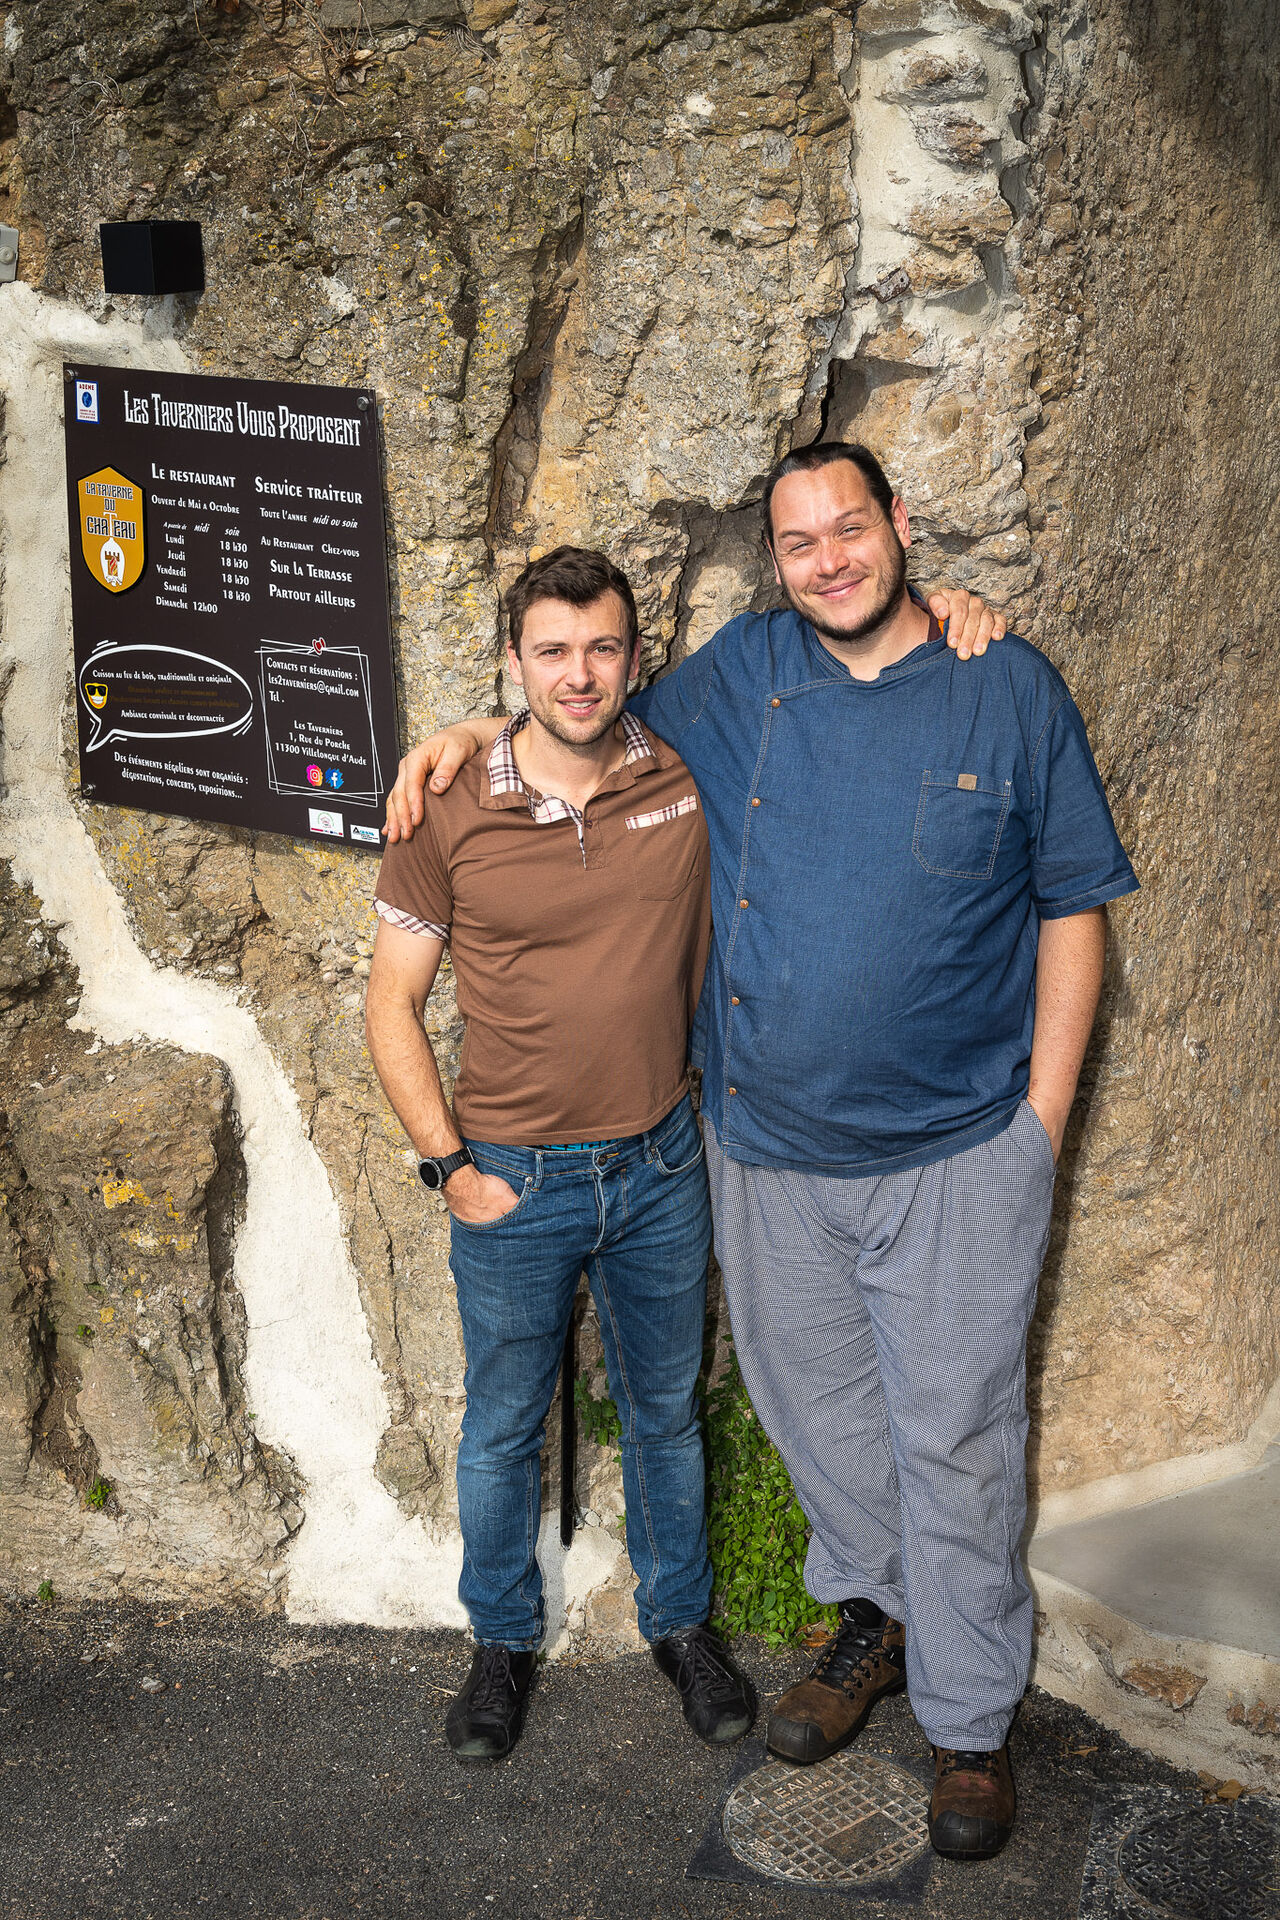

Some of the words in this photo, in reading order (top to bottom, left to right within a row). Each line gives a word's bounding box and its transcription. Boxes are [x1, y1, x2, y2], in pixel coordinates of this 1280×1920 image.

[86, 482, 96, 495] LA
[97, 483, 133, 500] TAVERNE
[104, 498, 115, 511] DU
[86, 512, 136, 540] CHATEAU
[193, 601, 218, 613] 12h00
[275, 742, 300, 754] 11300
[773, 1775, 813, 1799] EAU
